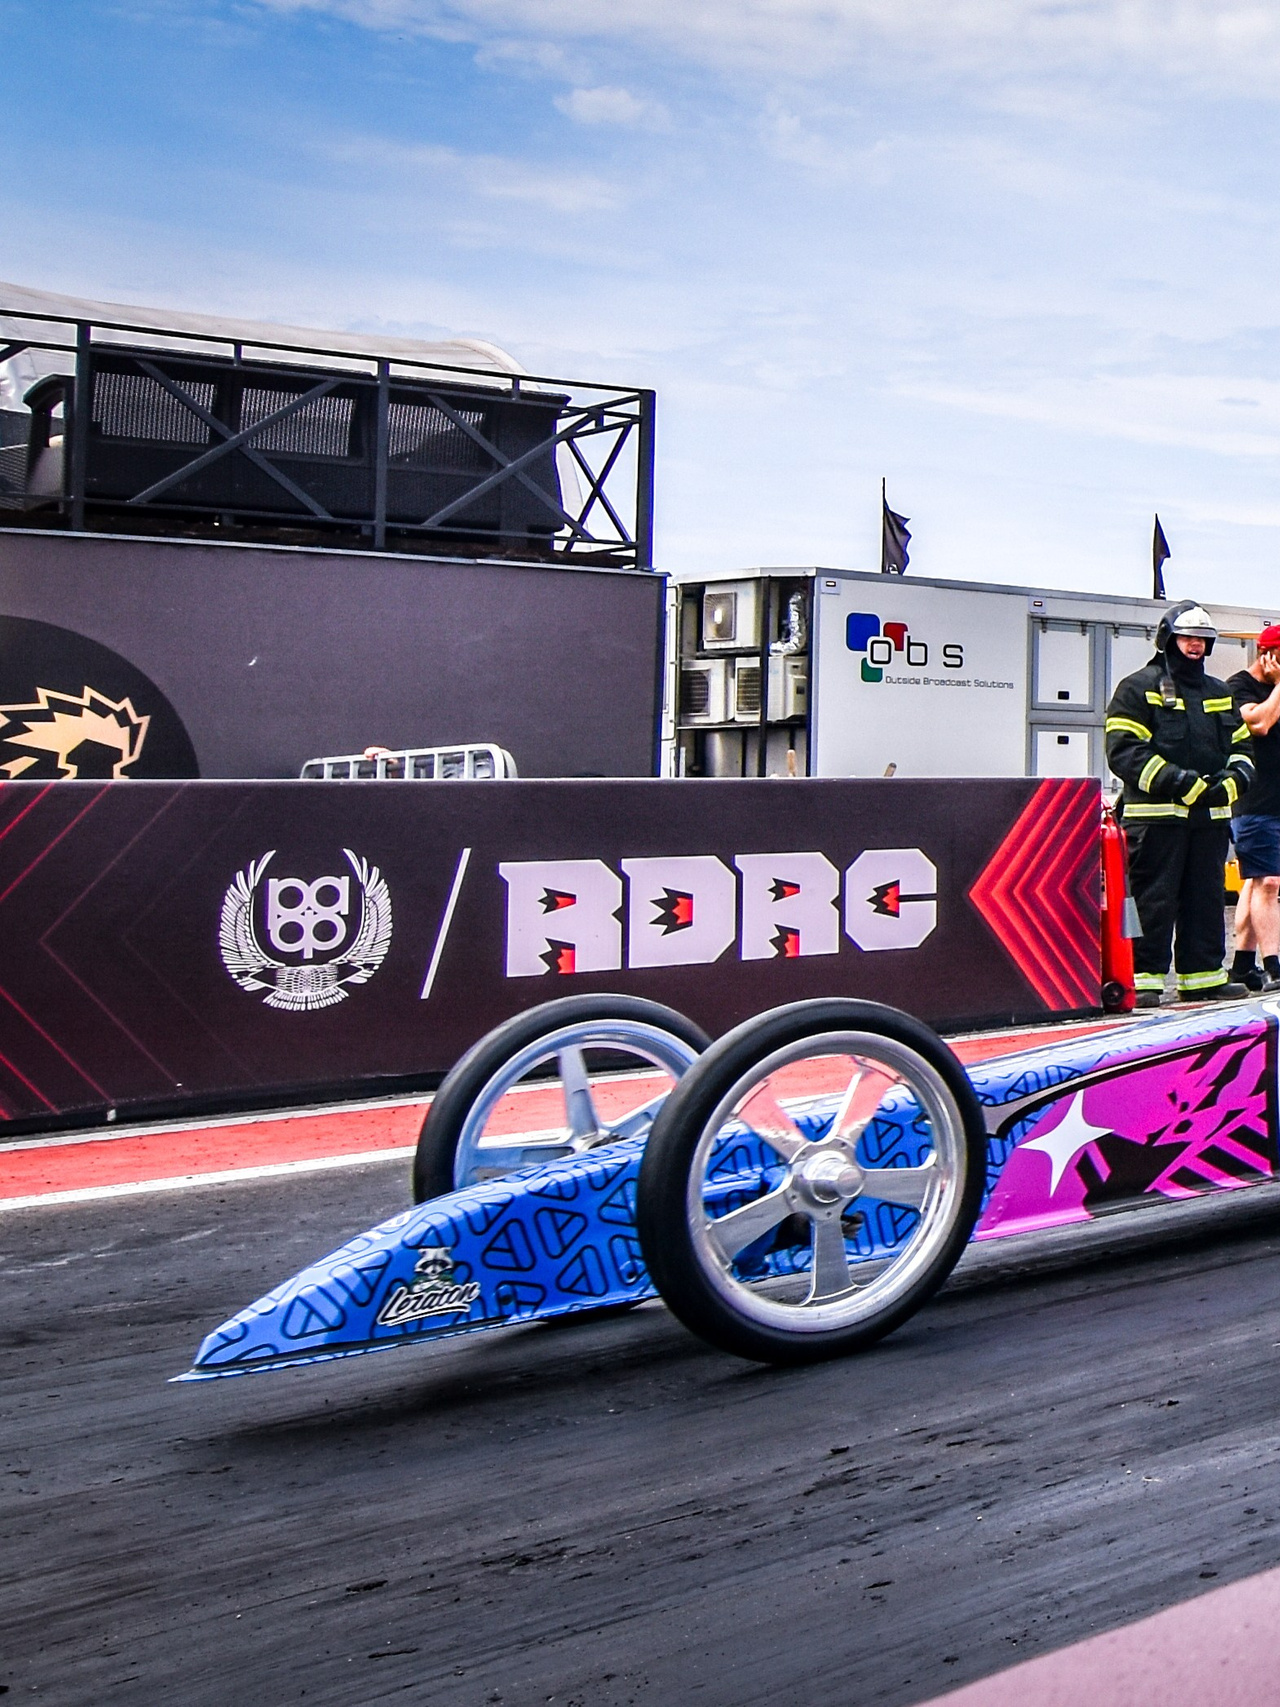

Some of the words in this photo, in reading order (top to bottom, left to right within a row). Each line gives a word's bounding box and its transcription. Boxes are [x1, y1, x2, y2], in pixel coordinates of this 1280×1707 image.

[885, 675, 921, 686] Outside
[923, 677, 972, 688] Broadcast
[974, 679, 1014, 689] Solutions
[498, 848, 938, 978] RDRC
